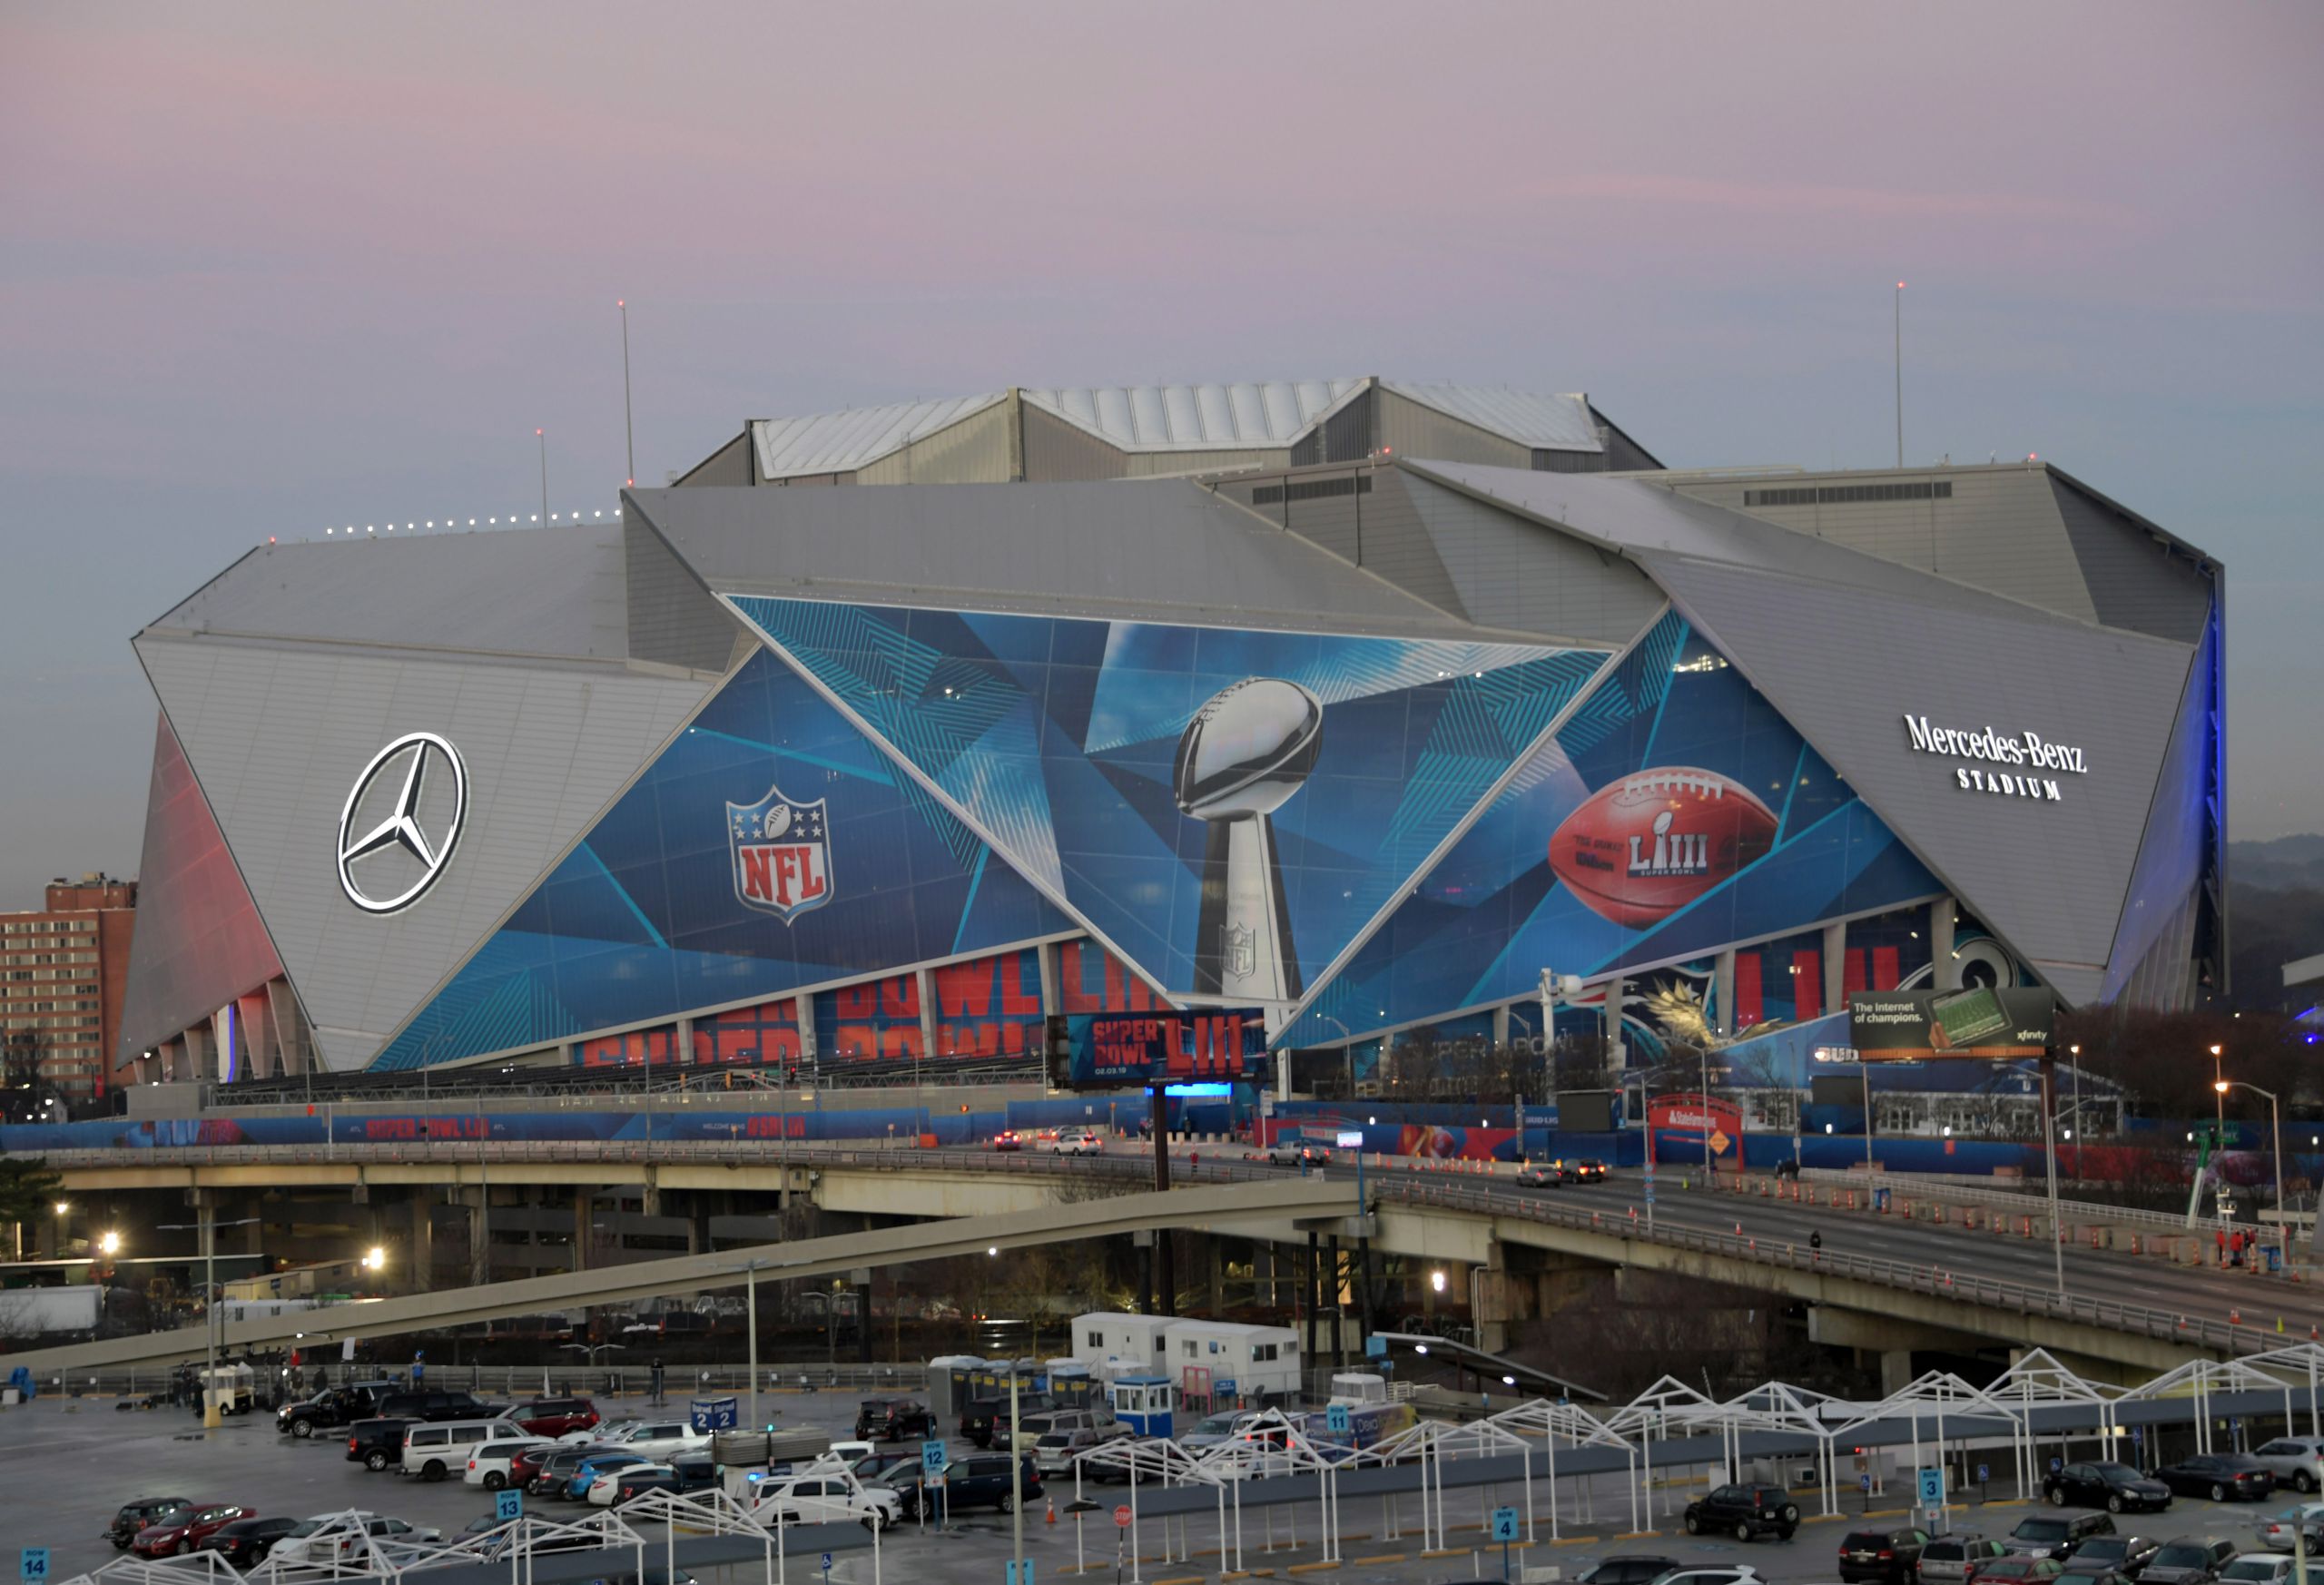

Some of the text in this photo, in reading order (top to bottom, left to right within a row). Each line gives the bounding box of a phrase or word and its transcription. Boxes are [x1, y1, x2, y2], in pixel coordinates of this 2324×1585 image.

[1904, 714, 2088, 773] Mercedes-Benz
[1956, 768, 2062, 802] STADIUM
[741, 846, 824, 907] NFL
[1855, 1002, 1915, 1013] The Internet
[1854, 1013, 1924, 1025] of champions.
[2016, 1029, 2048, 1042] xfinity
[1092, 1015, 1245, 1077] SUPER LIII
[1094, 1042, 1152, 1067] BOWL
[1815, 1047, 1859, 1063] BUD
[366, 1119, 416, 1138] SUPER
[1525, 1117, 1543, 1125] BUD
[696, 1413, 707, 1427] 2
[719, 1412, 730, 1427] 2
[1331, 1416, 1344, 1429] 11
[927, 1451, 942, 1465] 12
[1926, 1481, 1936, 1496] 3
[500, 1501, 518, 1516] 13
[1501, 1521, 1512, 1536] 4
[25, 1560, 45, 1575] 14
